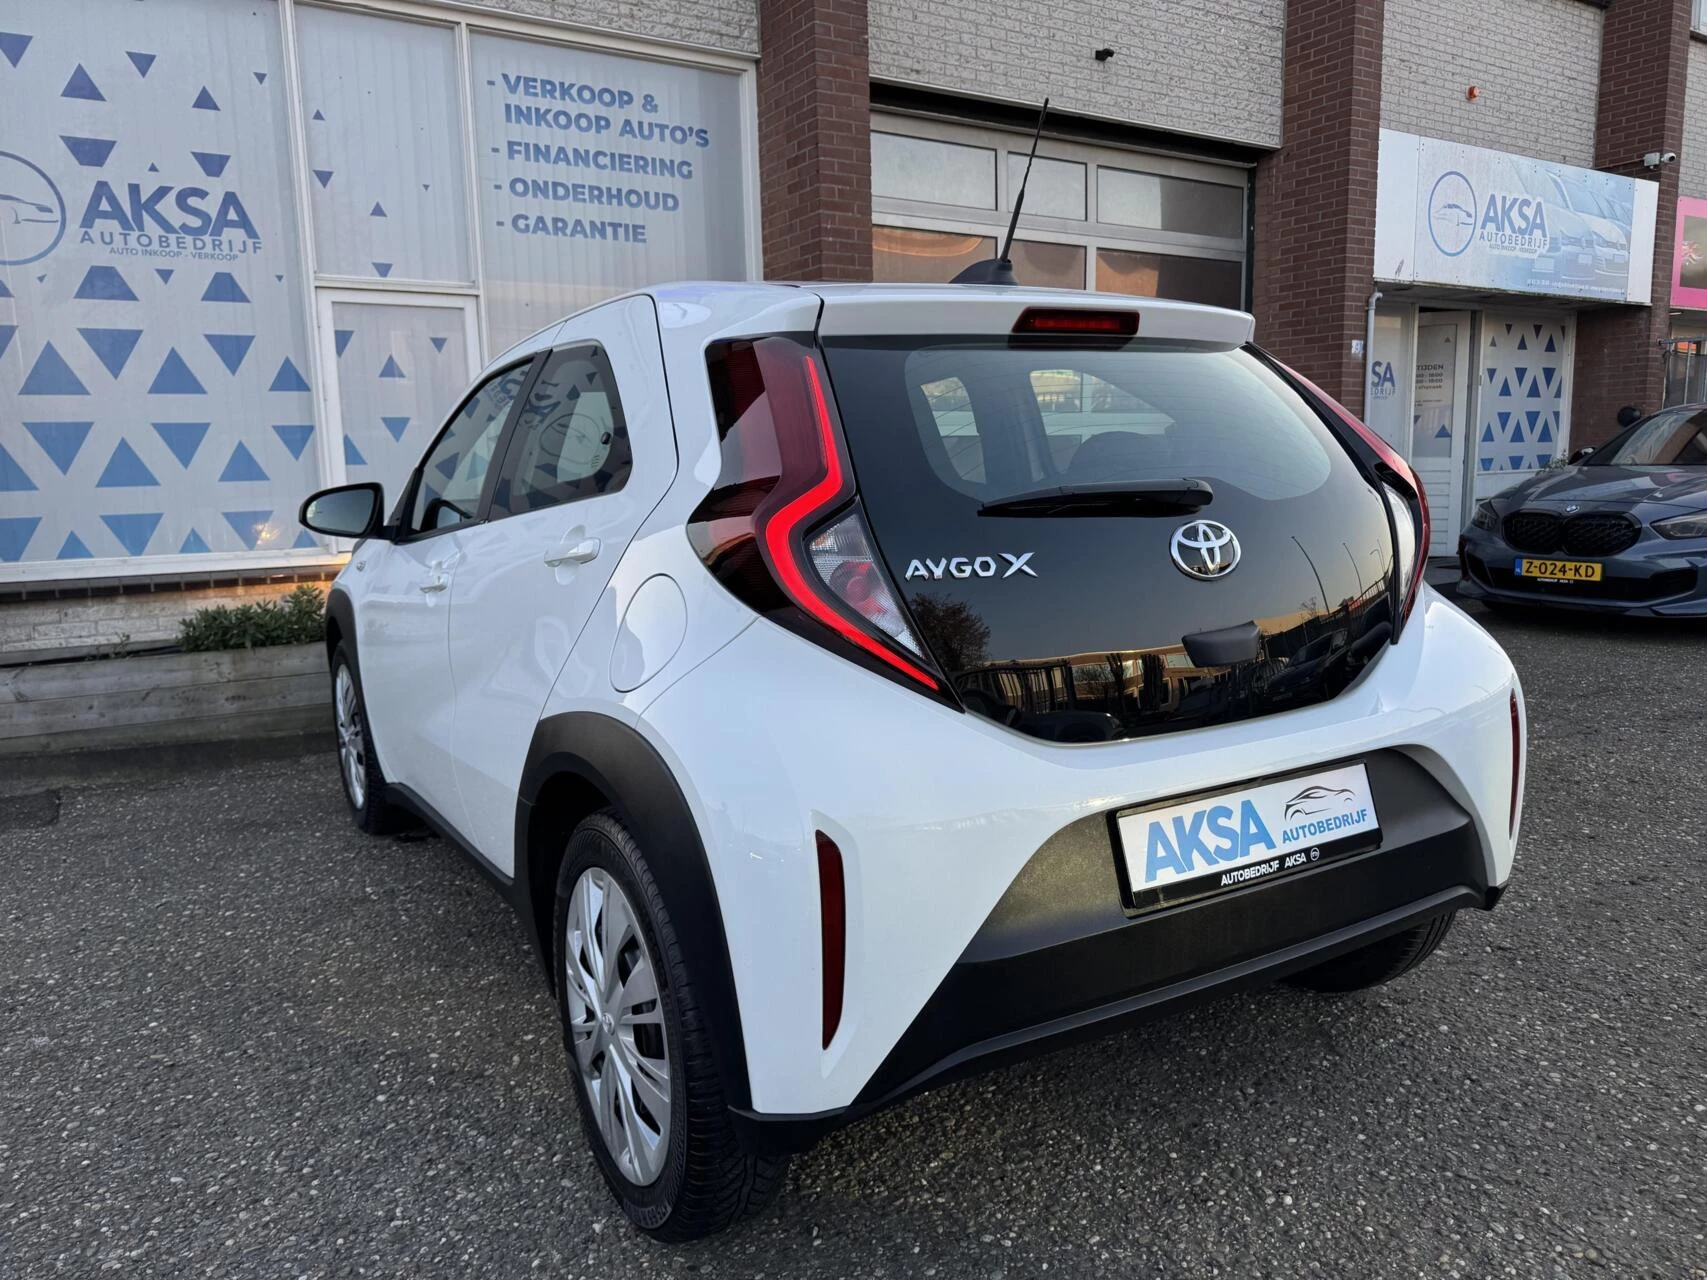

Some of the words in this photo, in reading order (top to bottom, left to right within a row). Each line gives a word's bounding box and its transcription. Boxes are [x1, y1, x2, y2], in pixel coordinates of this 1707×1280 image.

[501, 73, 634, 110] VERKOOP
[642, 94, 659, 114] &
[504, 103, 611, 134] INKOOP
[619, 119, 710, 148] AUTO'S
[507, 140, 693, 180] FINANCIERING
[79, 180, 261, 240] AKSA
[509, 177, 680, 212] ONDERHOUD
[511, 213, 648, 243] GARANTIE
[1480, 193, 1548, 239] AKSA
[79, 230, 263, 254] AUTOBEDRIJF
[109, 246, 139, 257] AUTO
[141, 248, 183, 259] INKOOP
[190, 251, 239, 262] VERKOOP
[1479, 231, 1548, 249] AUTOBEDRIJF
[904, 556, 997, 582] AYGO
[998, 552, 1039, 579] X
[1525, 561, 1596, 578] Z-024-KD
[1145, 800, 1277, 883] AKSA
[1282, 808, 1368, 844] AUTOBEDRIJF
[1220, 860, 1280, 887] AUTOBEDRIJF
[1284, 852, 1307, 869] AKSA
